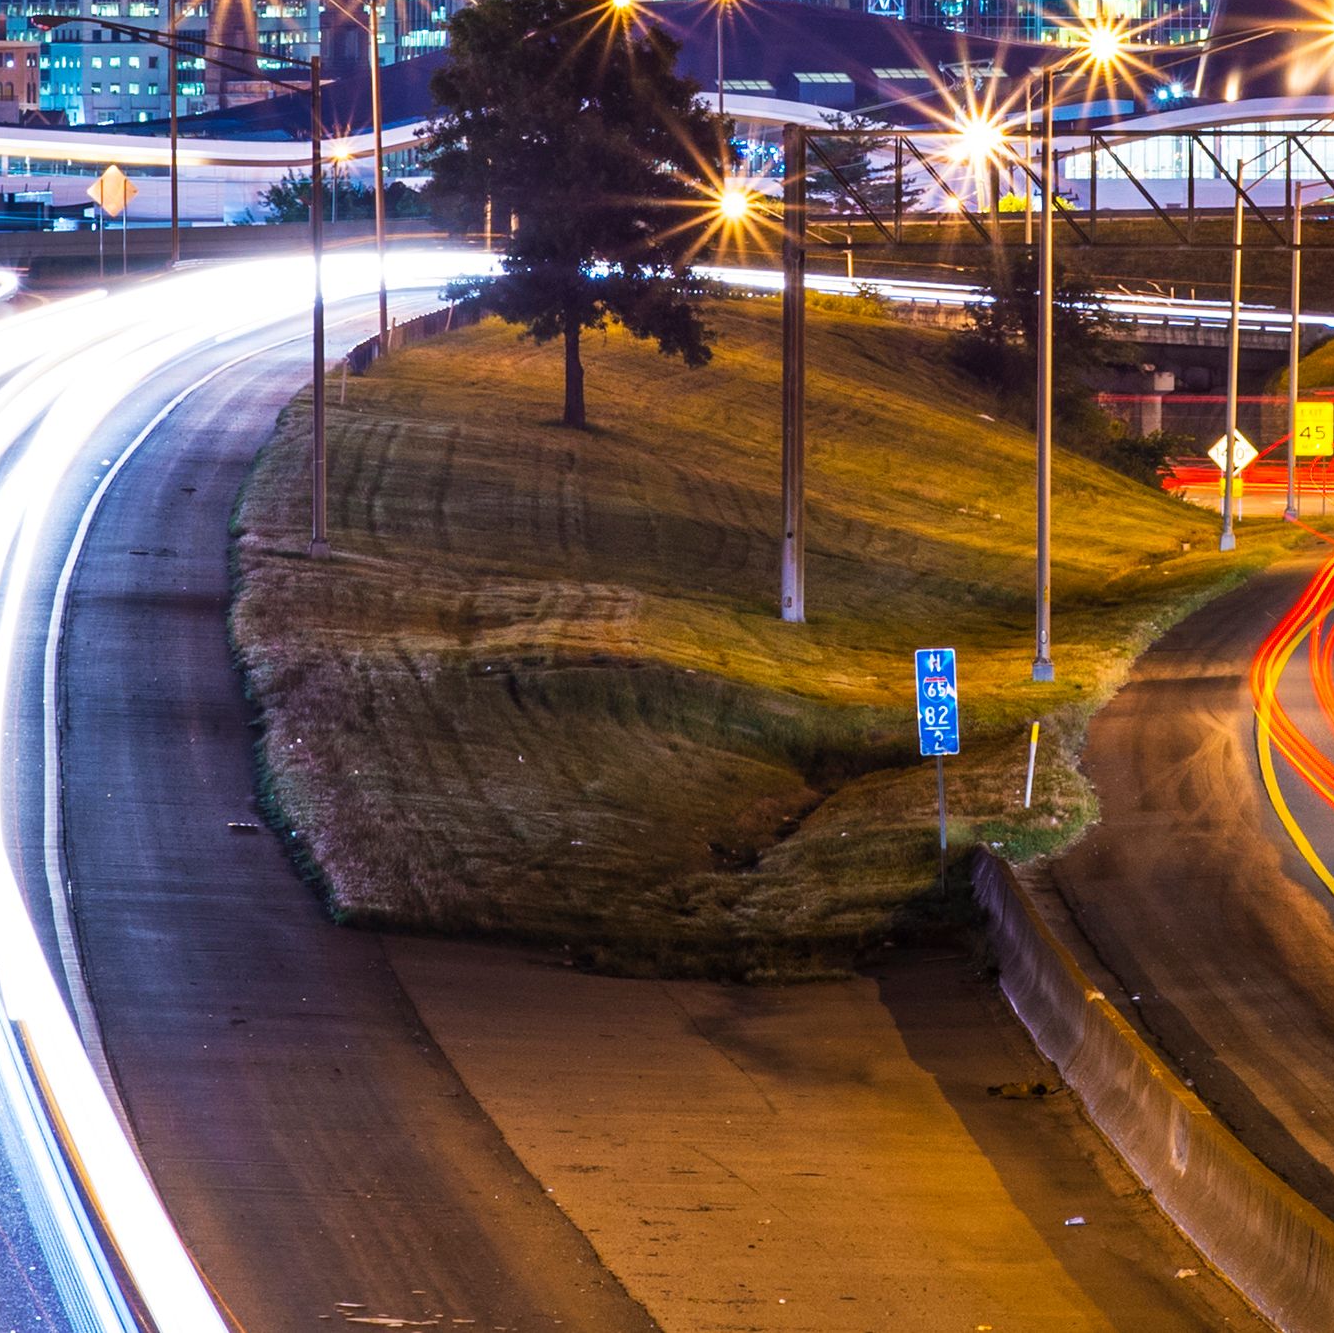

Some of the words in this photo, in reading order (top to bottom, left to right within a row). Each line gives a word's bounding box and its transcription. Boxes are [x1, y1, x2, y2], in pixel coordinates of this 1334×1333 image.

[1299, 425, 1326, 440] 45
[927, 682, 946, 698] 65
[925, 706, 948, 725] 82
